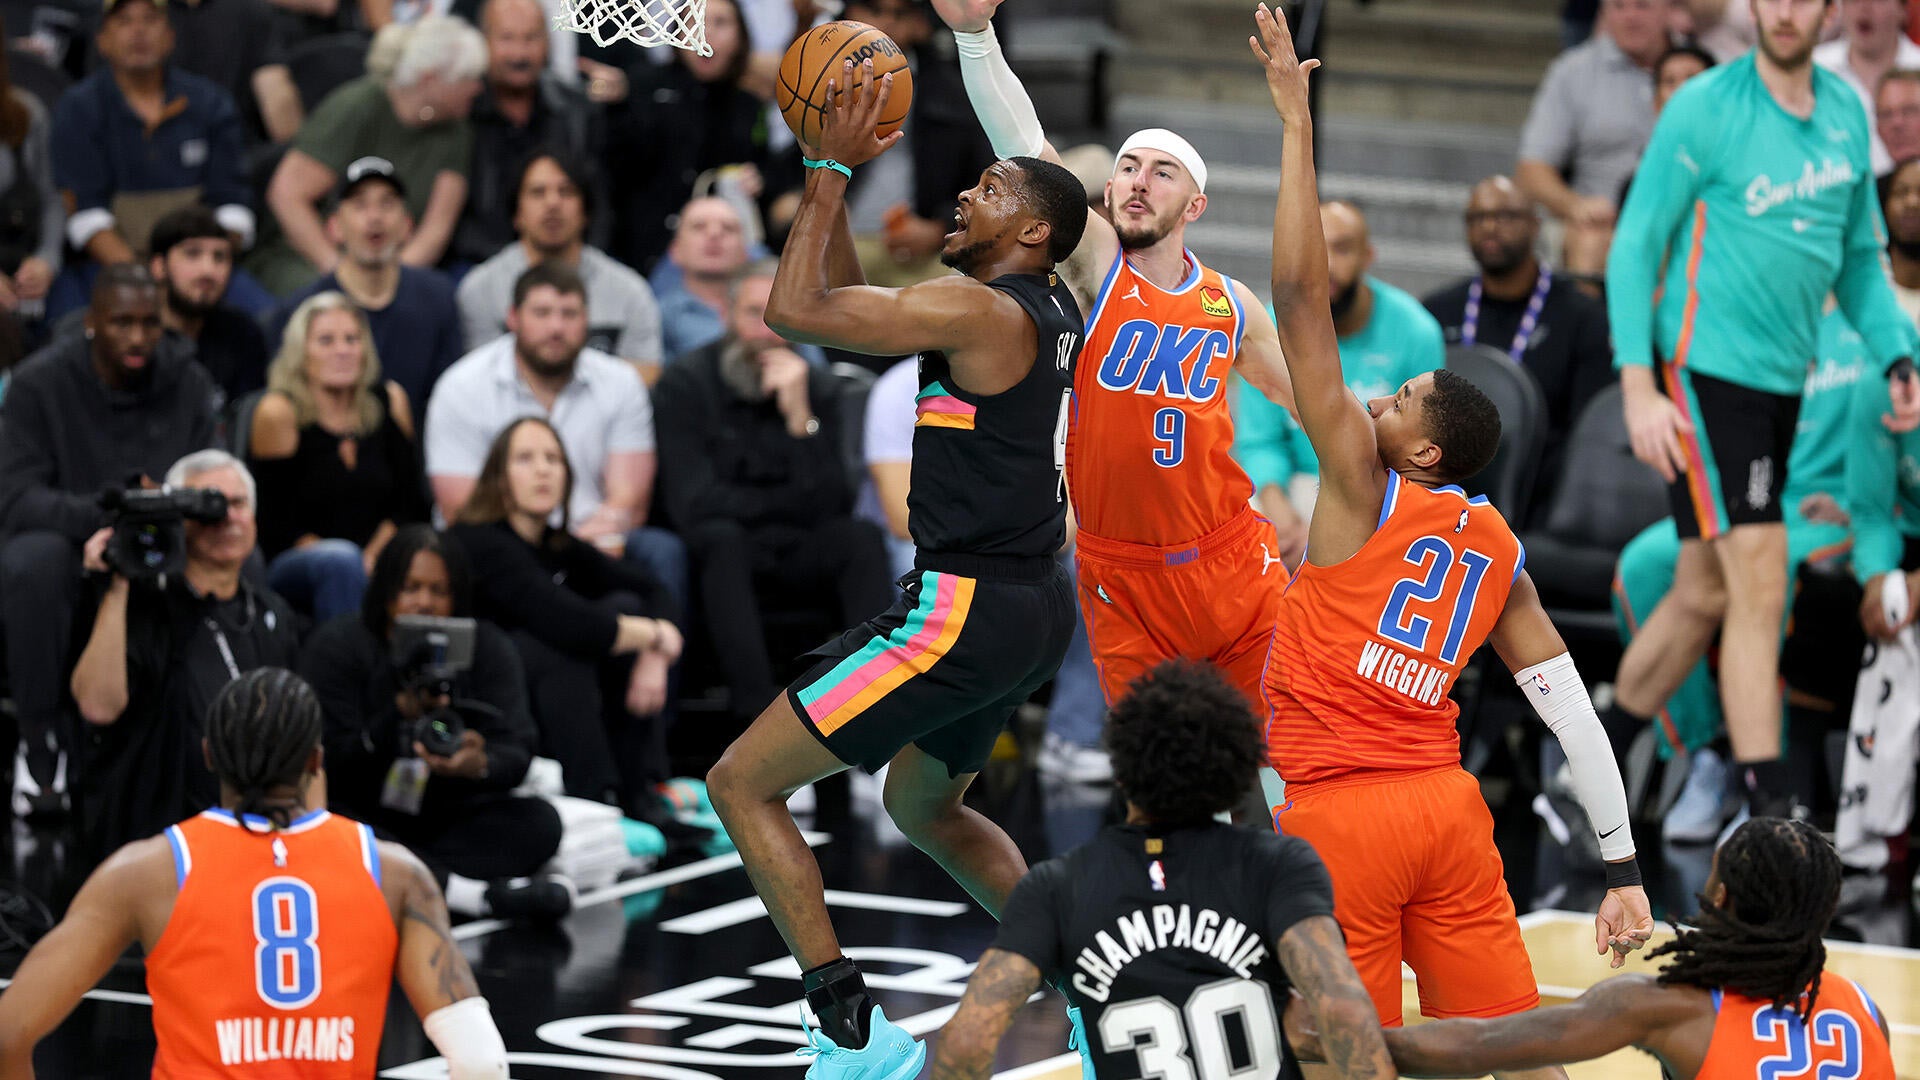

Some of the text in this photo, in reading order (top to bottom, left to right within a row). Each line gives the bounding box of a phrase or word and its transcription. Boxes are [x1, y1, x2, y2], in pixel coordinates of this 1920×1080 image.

[1056, 331, 1078, 371] FOX
[1097, 318, 1231, 403] OKC
[1152, 406, 1187, 469] 9
[1376, 534, 1495, 667] 21
[1355, 639, 1450, 707] WIGGINS
[251, 875, 323, 1011] 8
[1071, 903, 1270, 1003] CHAMPAGNIE
[215, 1015, 355, 1066] WILLIAMS
[1097, 976, 1284, 1080] 30
[1751, 1003, 1863, 1080] 22
